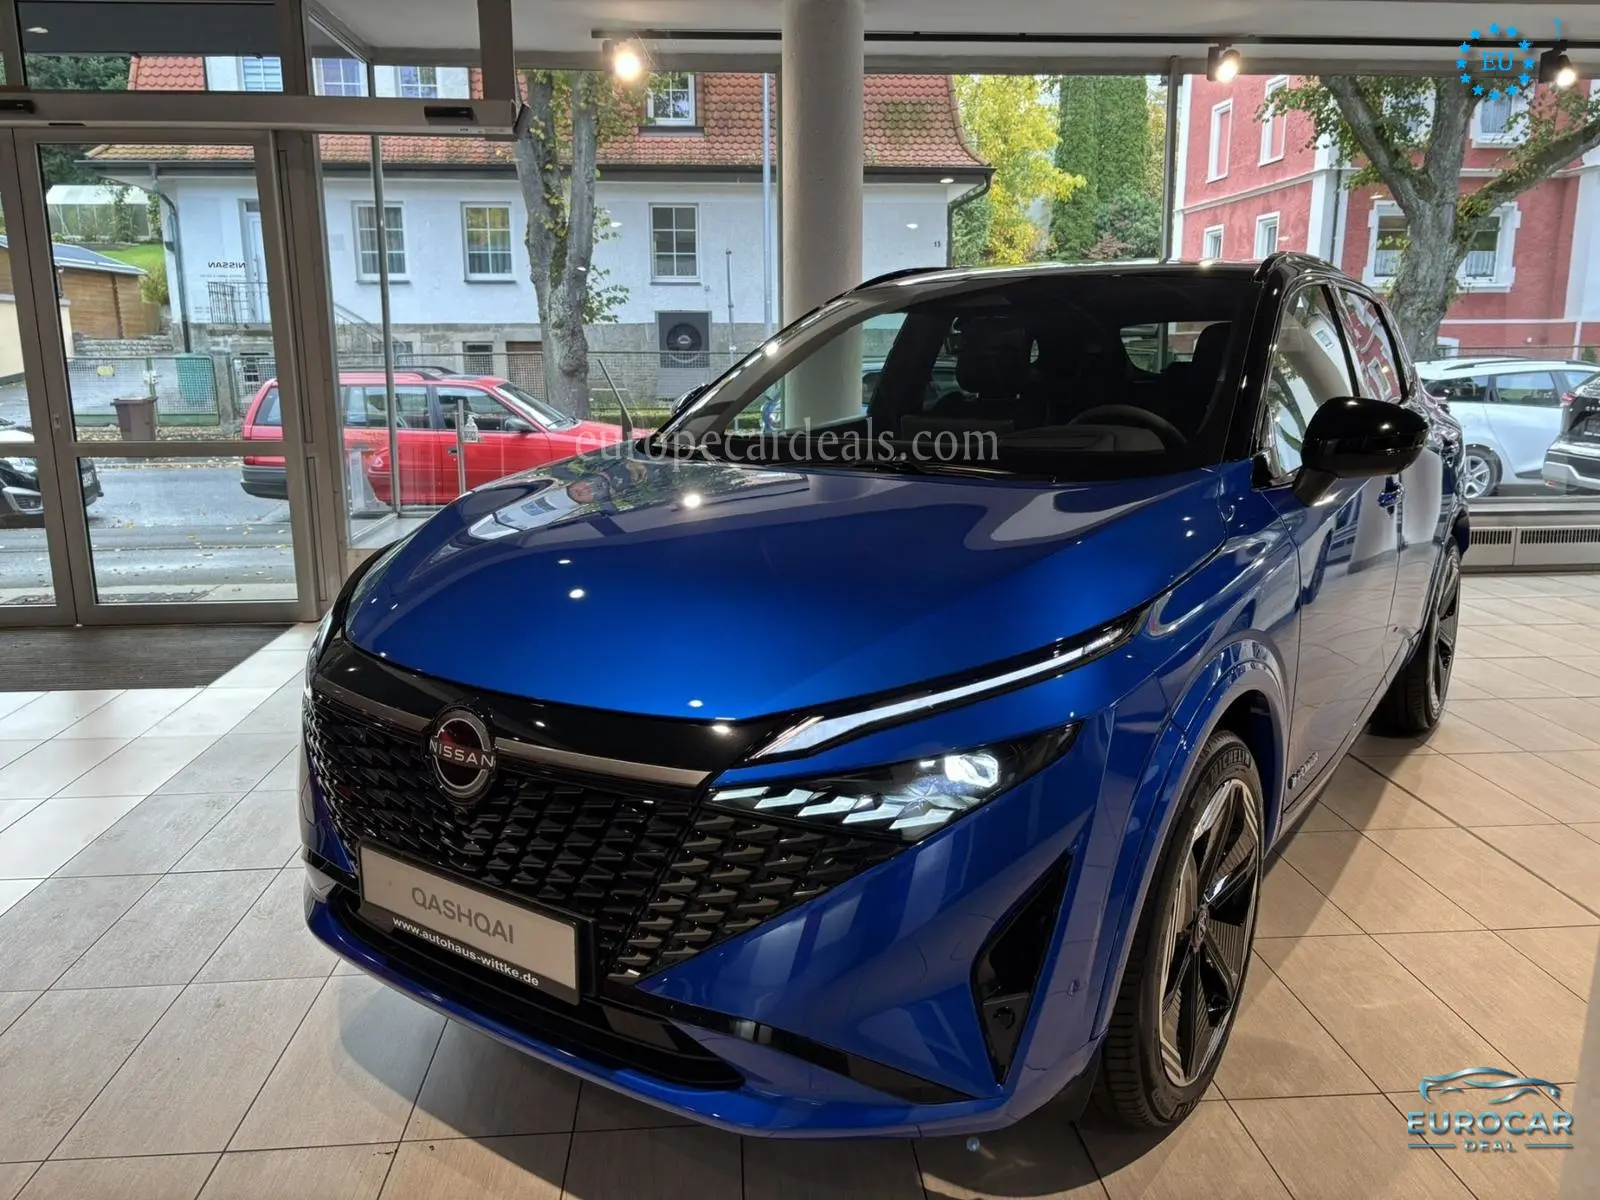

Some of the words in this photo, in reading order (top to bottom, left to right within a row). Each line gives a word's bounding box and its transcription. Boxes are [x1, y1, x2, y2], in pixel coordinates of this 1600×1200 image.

[429, 738, 495, 768] NISSAN
[411, 886, 514, 945] QASHQAI
[392, 916, 539, 987] www.autohaus-wittke.de
